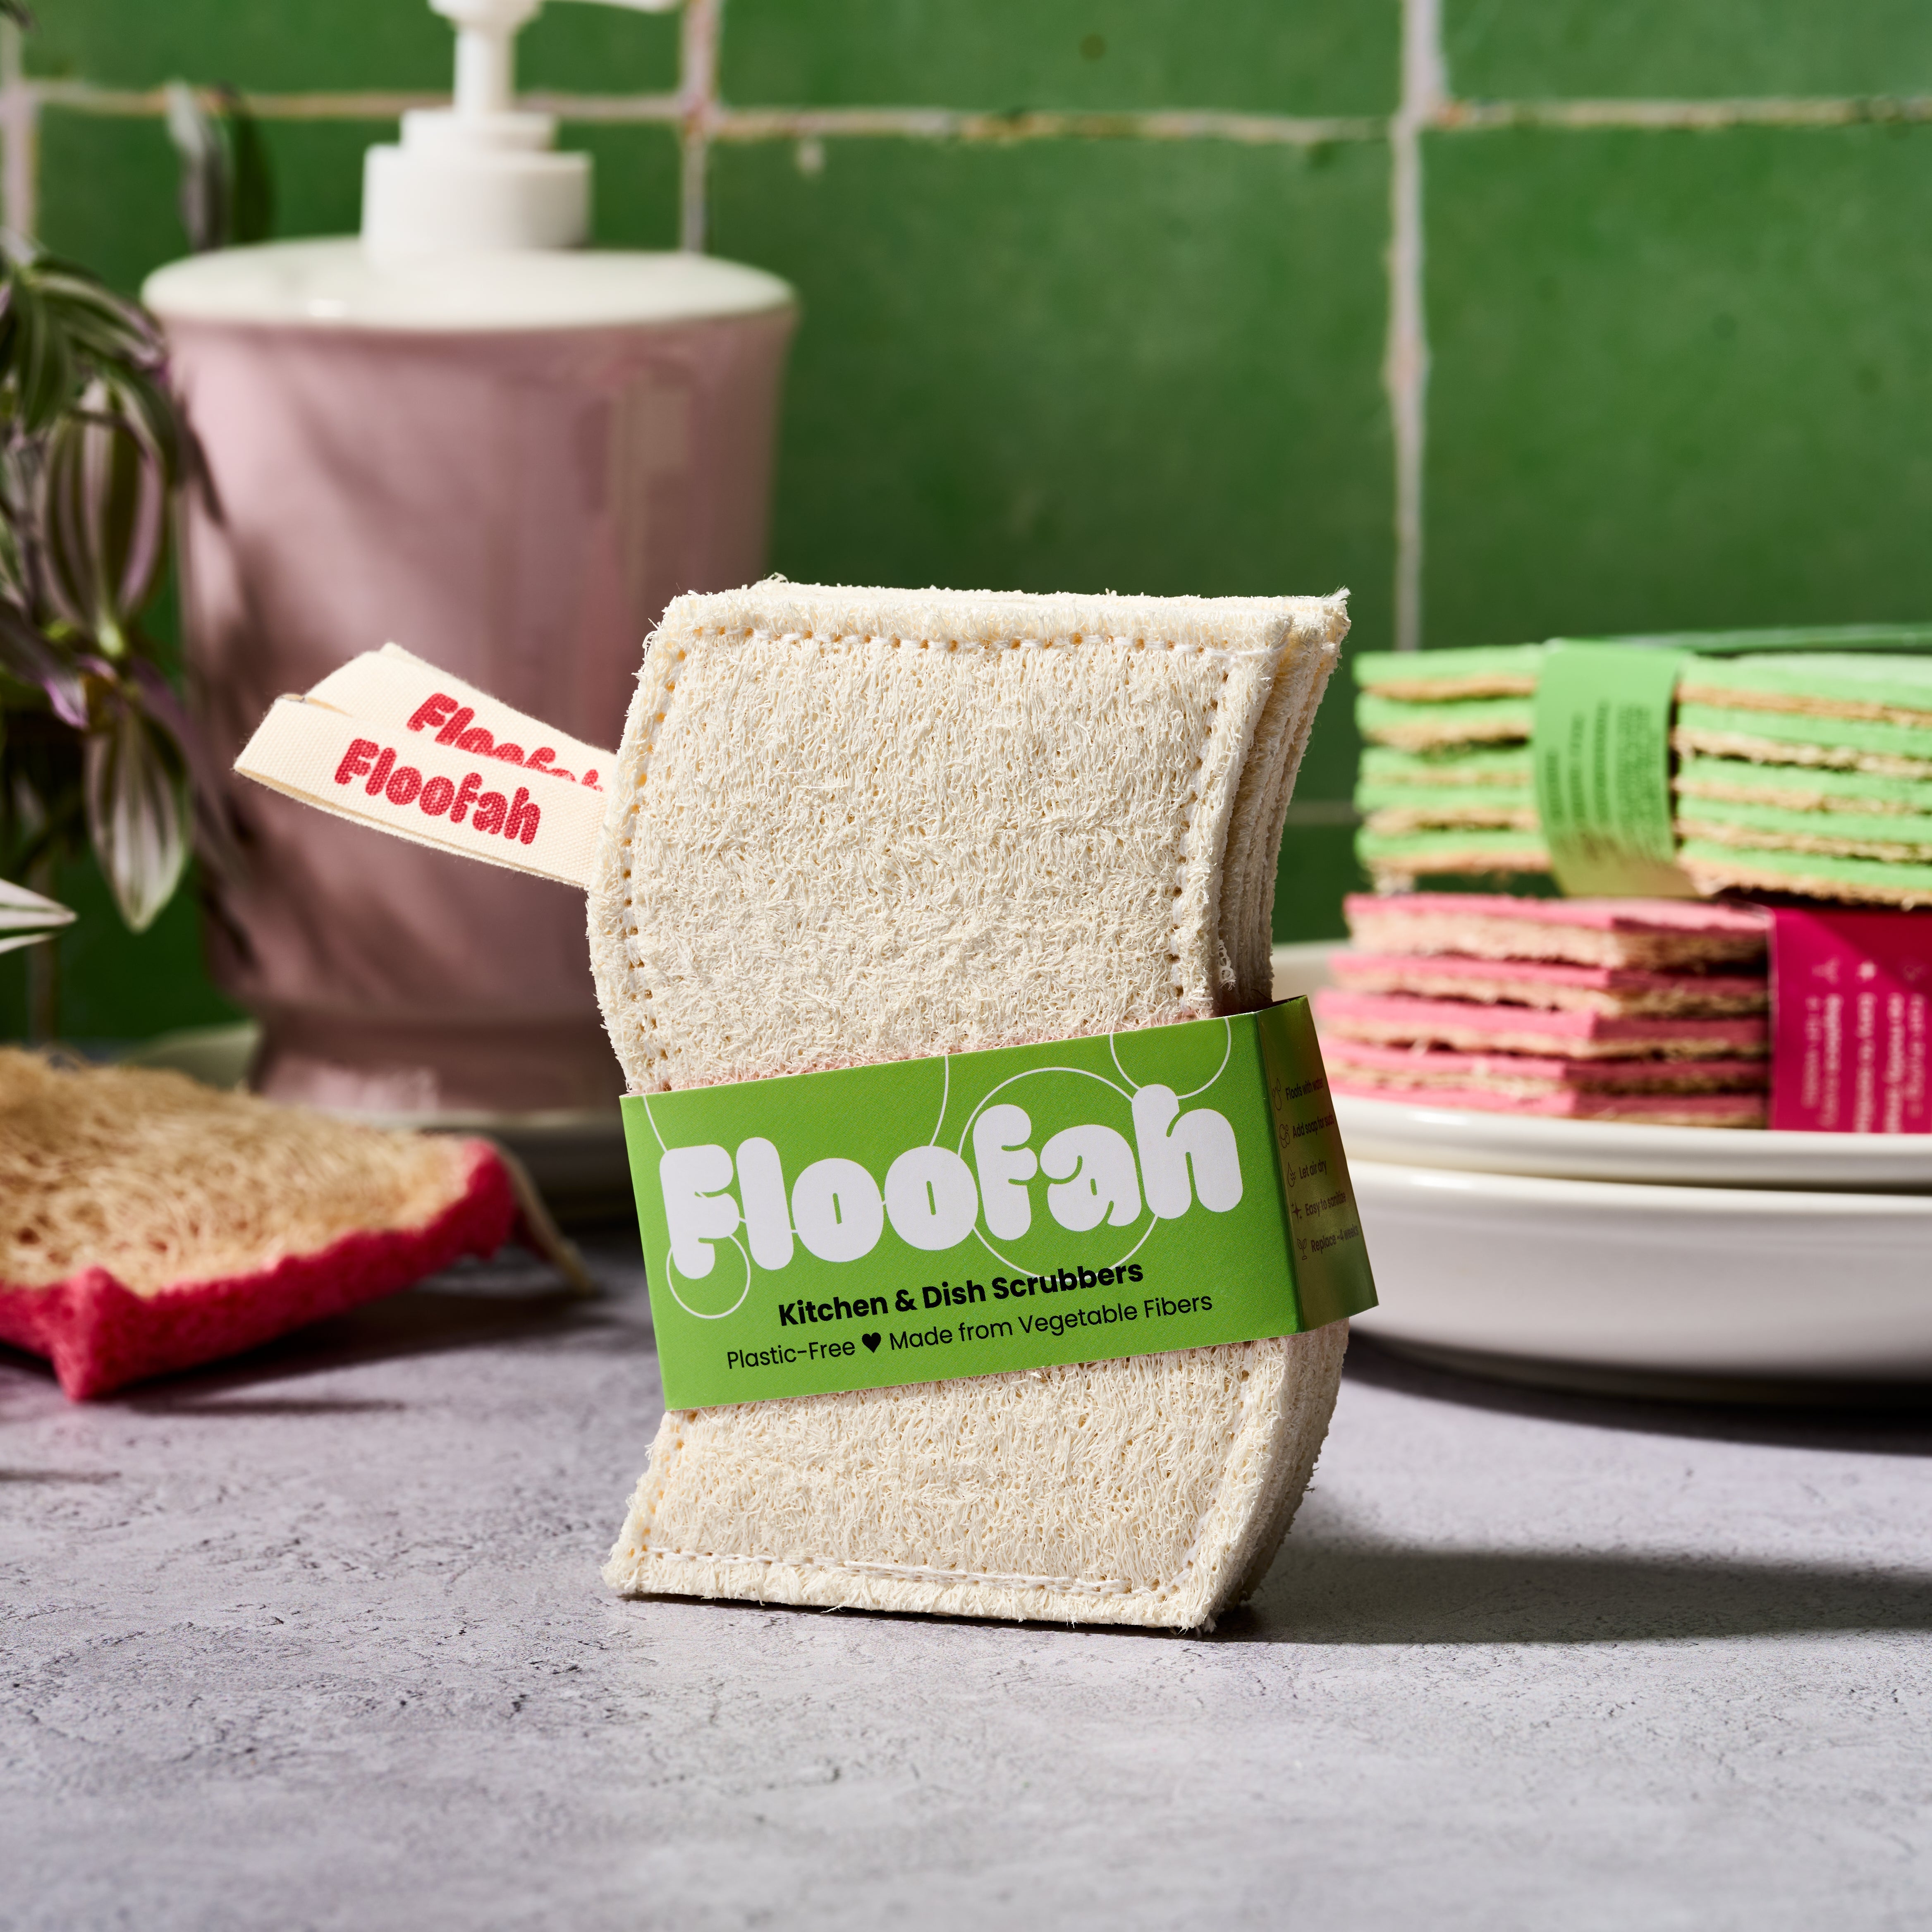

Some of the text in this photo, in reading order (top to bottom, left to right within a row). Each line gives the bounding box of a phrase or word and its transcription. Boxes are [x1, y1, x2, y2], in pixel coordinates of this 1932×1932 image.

[335, 739, 541, 844] Floofah
[1286, 1077, 1323, 1100] Floofs with water
[1293, 1122, 1305, 1138] Add
[1305, 1121, 1318, 1135] soap
[1325, 1112, 1334, 1127] suds
[659, 1084, 1243, 1279] Floofah
[1299, 1164, 1308, 1179] Let
[1318, 1159, 1327, 1175] dry
[1305, 1190, 1346, 1217] Easy to sanitize
[1310, 1235, 1337, 1254] Replace
[1344, 1224, 1359, 1240] weeks
[779, 1264, 1143, 1326] Kitchen & Dish Scrubbers
[727, 1295, 1212, 1369] Plastic-Free Made from Vegetable Fibers
